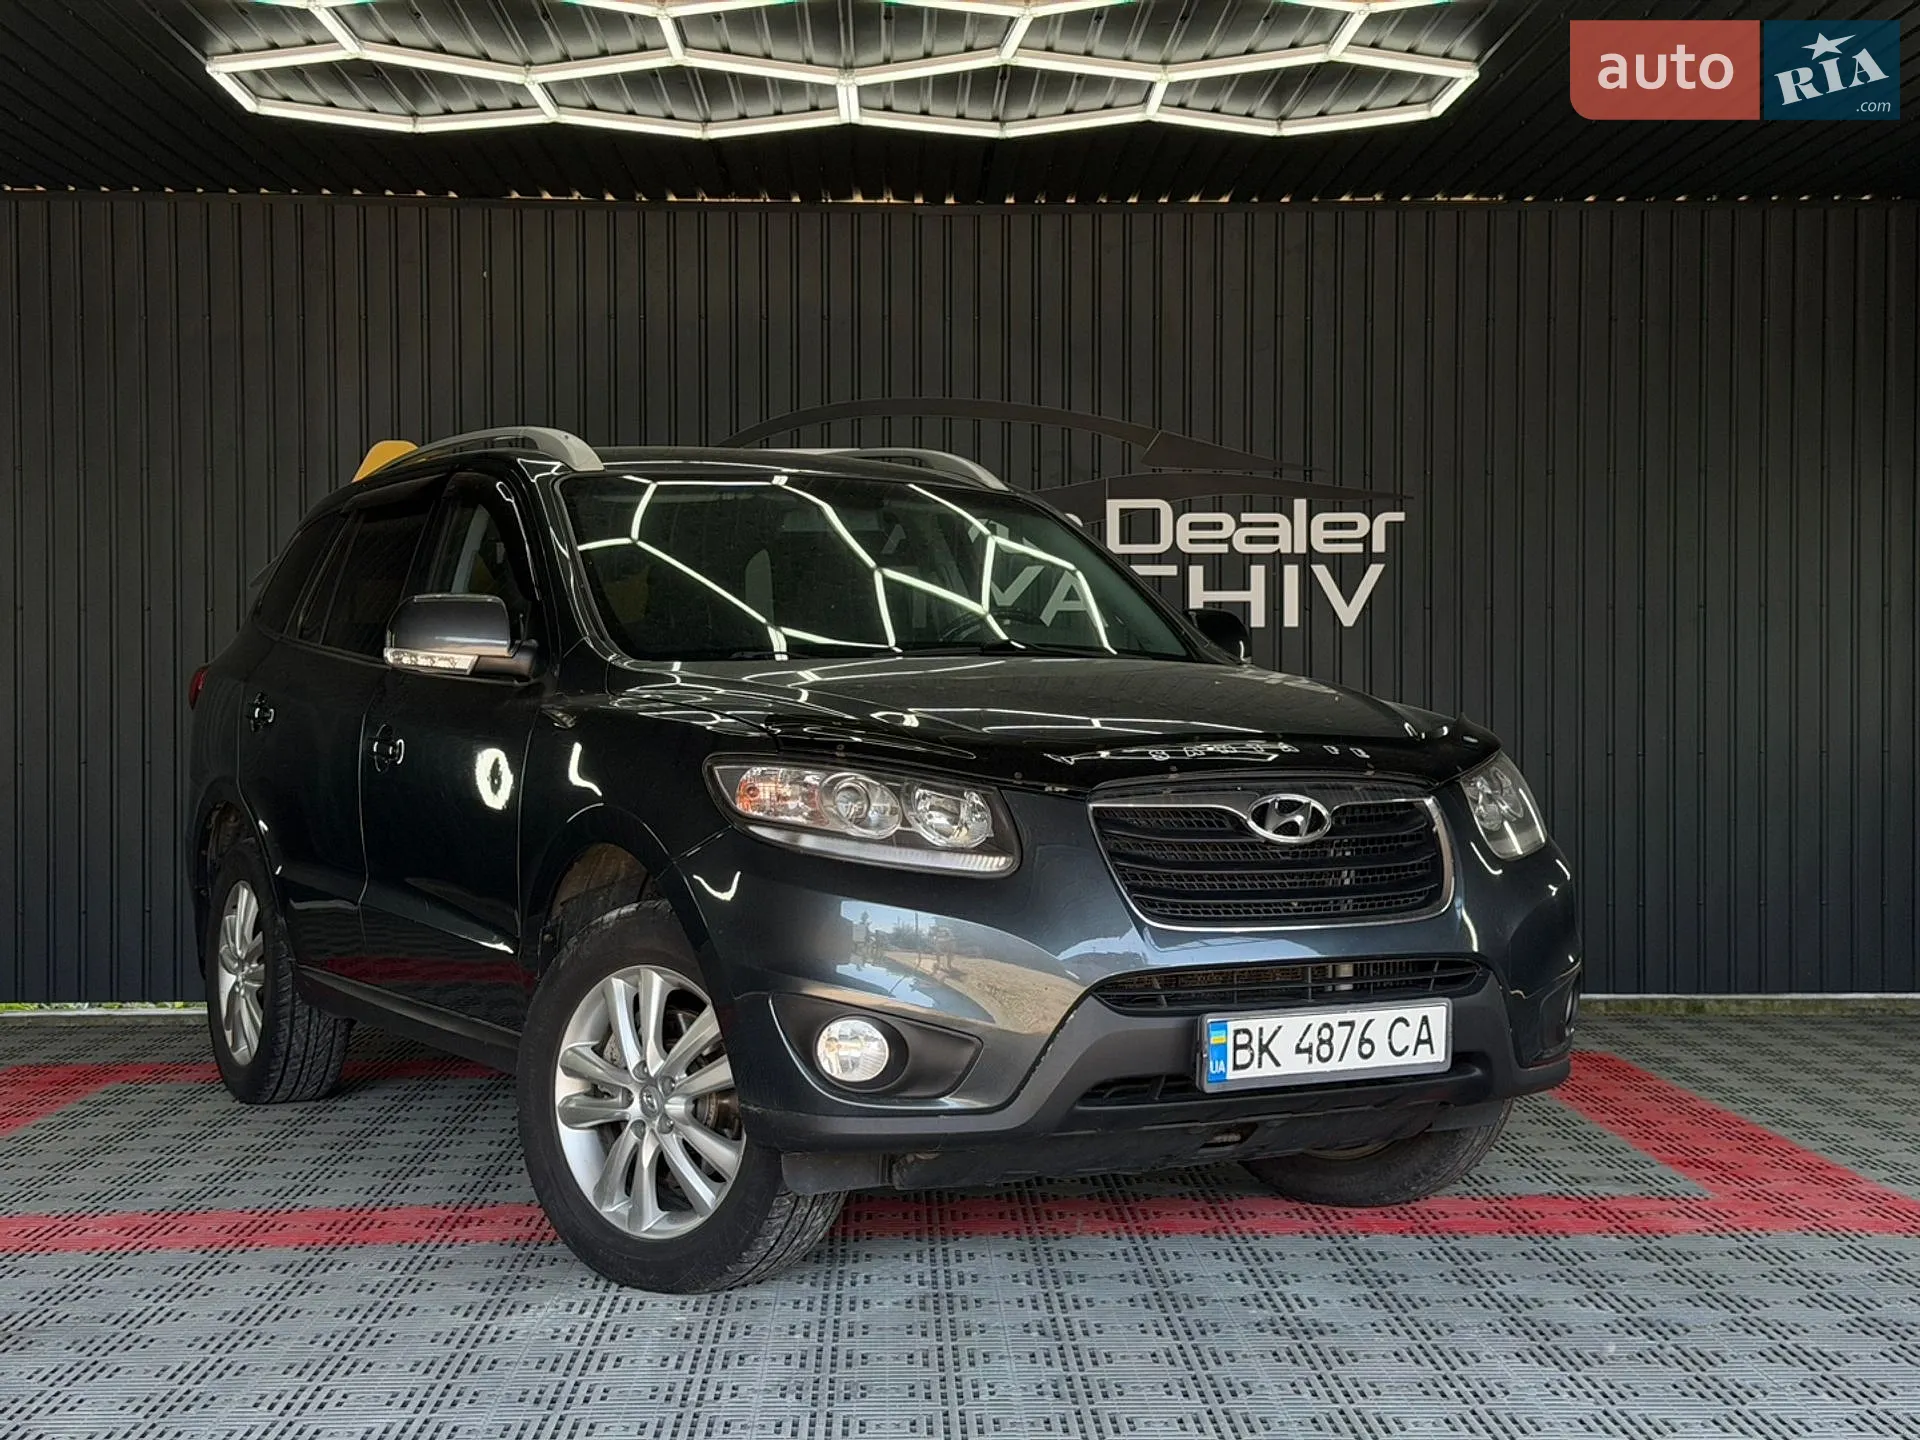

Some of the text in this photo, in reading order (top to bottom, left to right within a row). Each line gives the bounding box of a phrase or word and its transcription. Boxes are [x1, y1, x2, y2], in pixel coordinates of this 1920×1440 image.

[1106, 499, 1405, 554] Dealer
[1210, 1060, 1225, 1074] UA
[1232, 1015, 1435, 1072] BK 4876 CA
